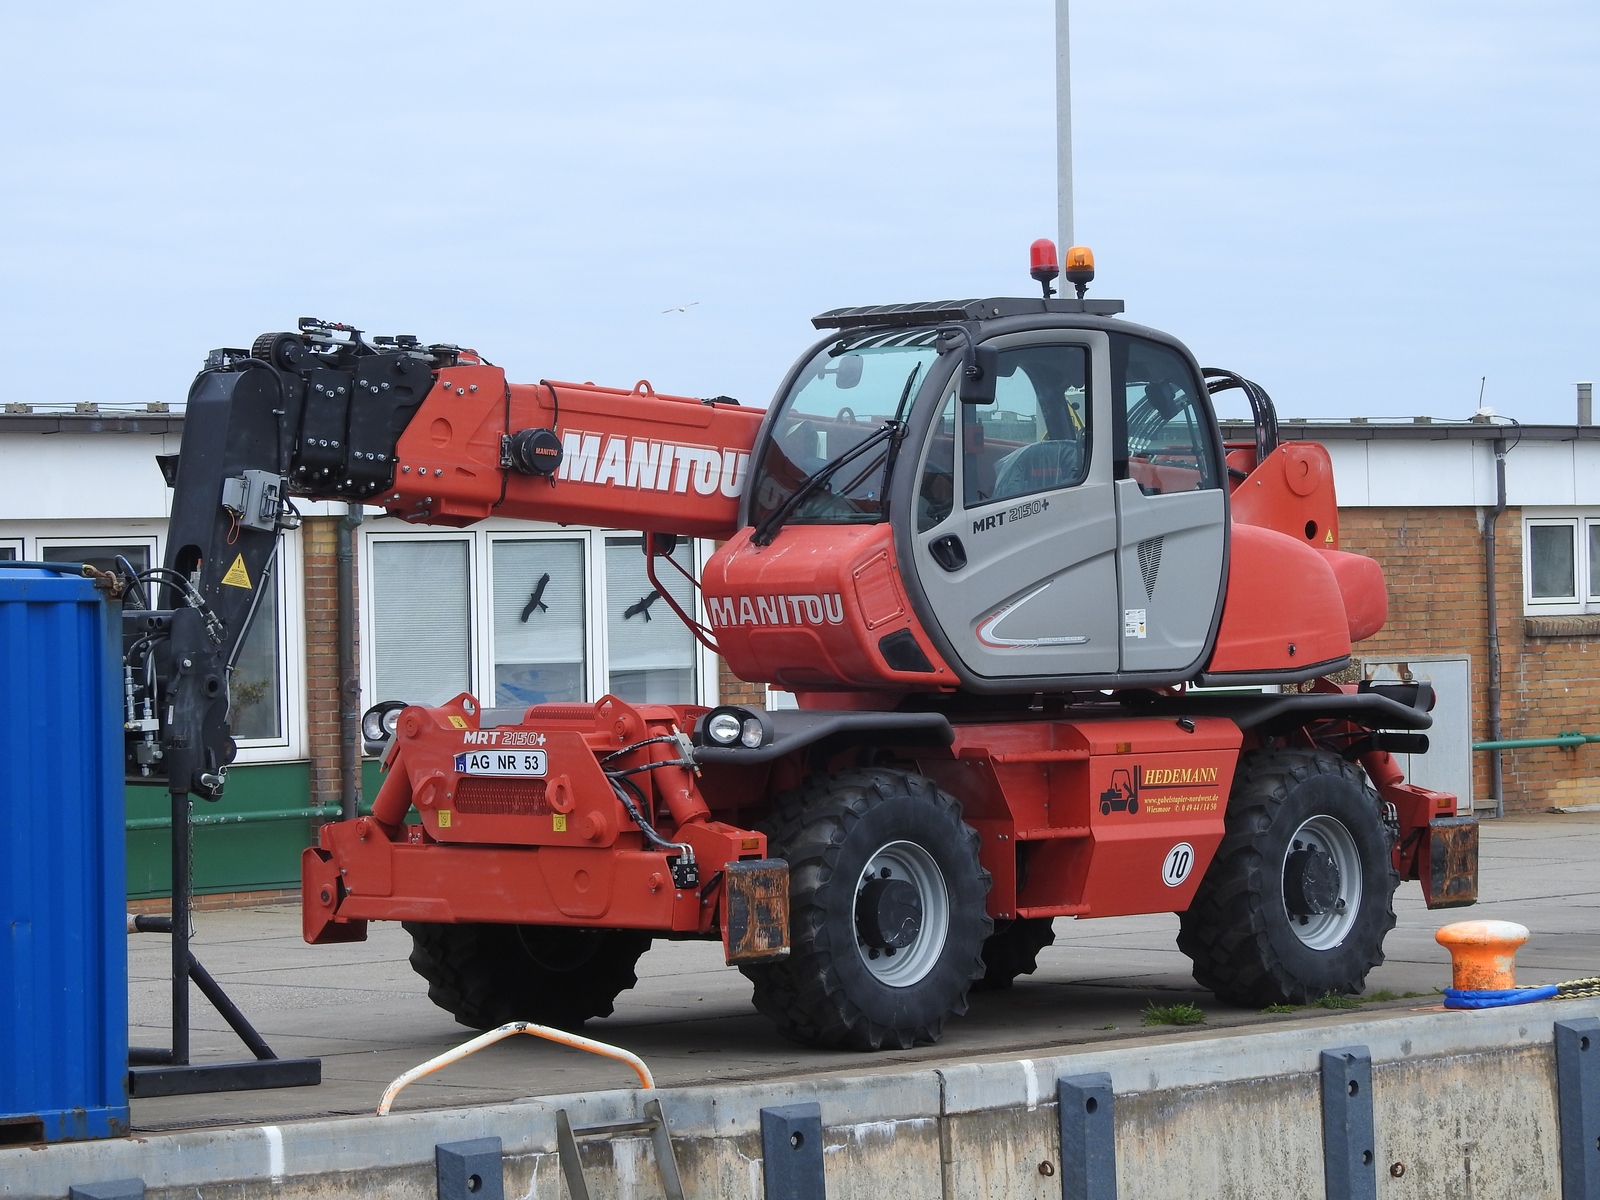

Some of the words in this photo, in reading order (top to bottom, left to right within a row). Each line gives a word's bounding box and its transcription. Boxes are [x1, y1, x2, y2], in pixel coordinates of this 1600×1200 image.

[535, 447, 558, 457] MANITOU
[557, 430, 749, 498] MANITOU
[973, 511, 1006, 535] MRT
[1008, 499, 1050, 523] 2150+
[708, 593, 845, 626] MANITOU
[463, 731, 501, 745] MRT
[502, 731, 546, 746] 2150+
[470, 755, 490, 769] AG
[498, 755, 516, 770] NR
[524, 755, 539, 770] 53
[1144, 767, 1219, 785] HEDEMANN
[1144, 794, 1219, 806] www.gabelstapler-nordwest.de
[1169, 850, 1190, 879] 10
